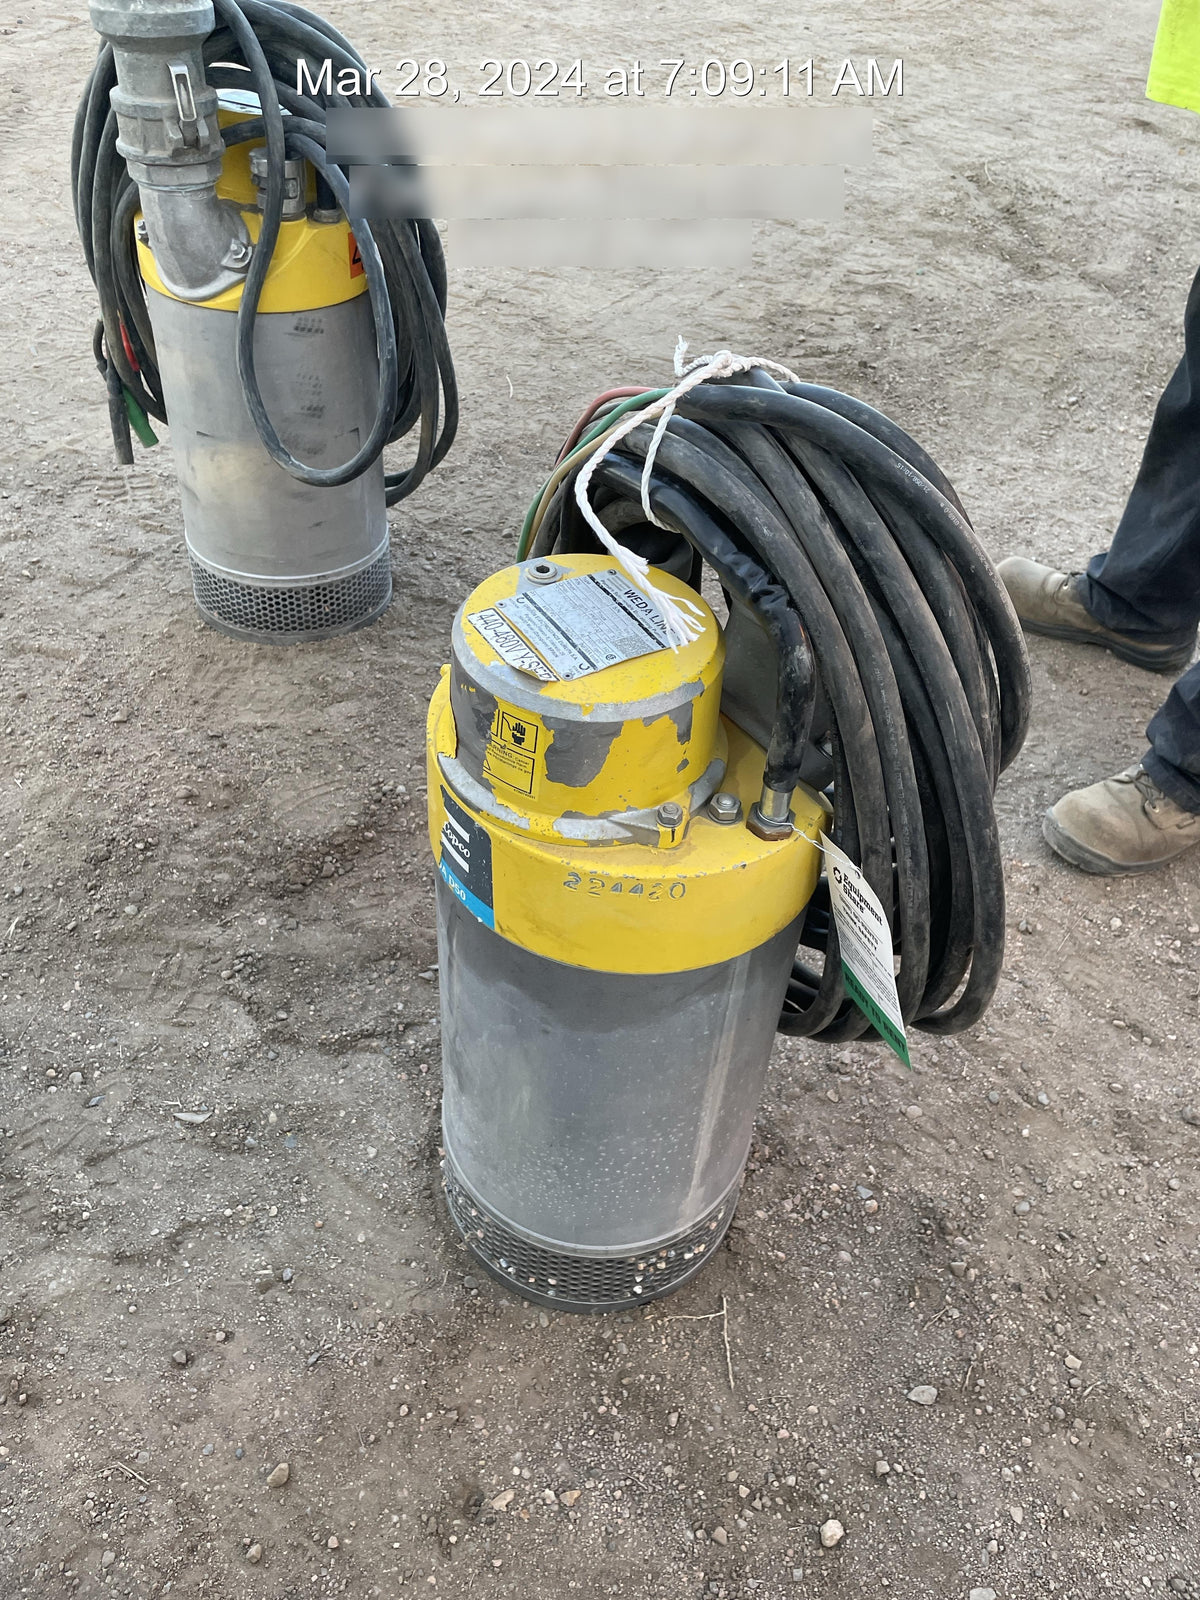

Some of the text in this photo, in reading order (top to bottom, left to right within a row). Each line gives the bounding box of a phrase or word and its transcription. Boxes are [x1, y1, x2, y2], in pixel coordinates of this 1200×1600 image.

[624, 589, 653, 616] WEDA
[479, 614, 527, 653] 440-480V
[448, 874, 466, 901] D50
[843, 883, 865, 914] Share
[843, 872, 883, 926] Equipment
